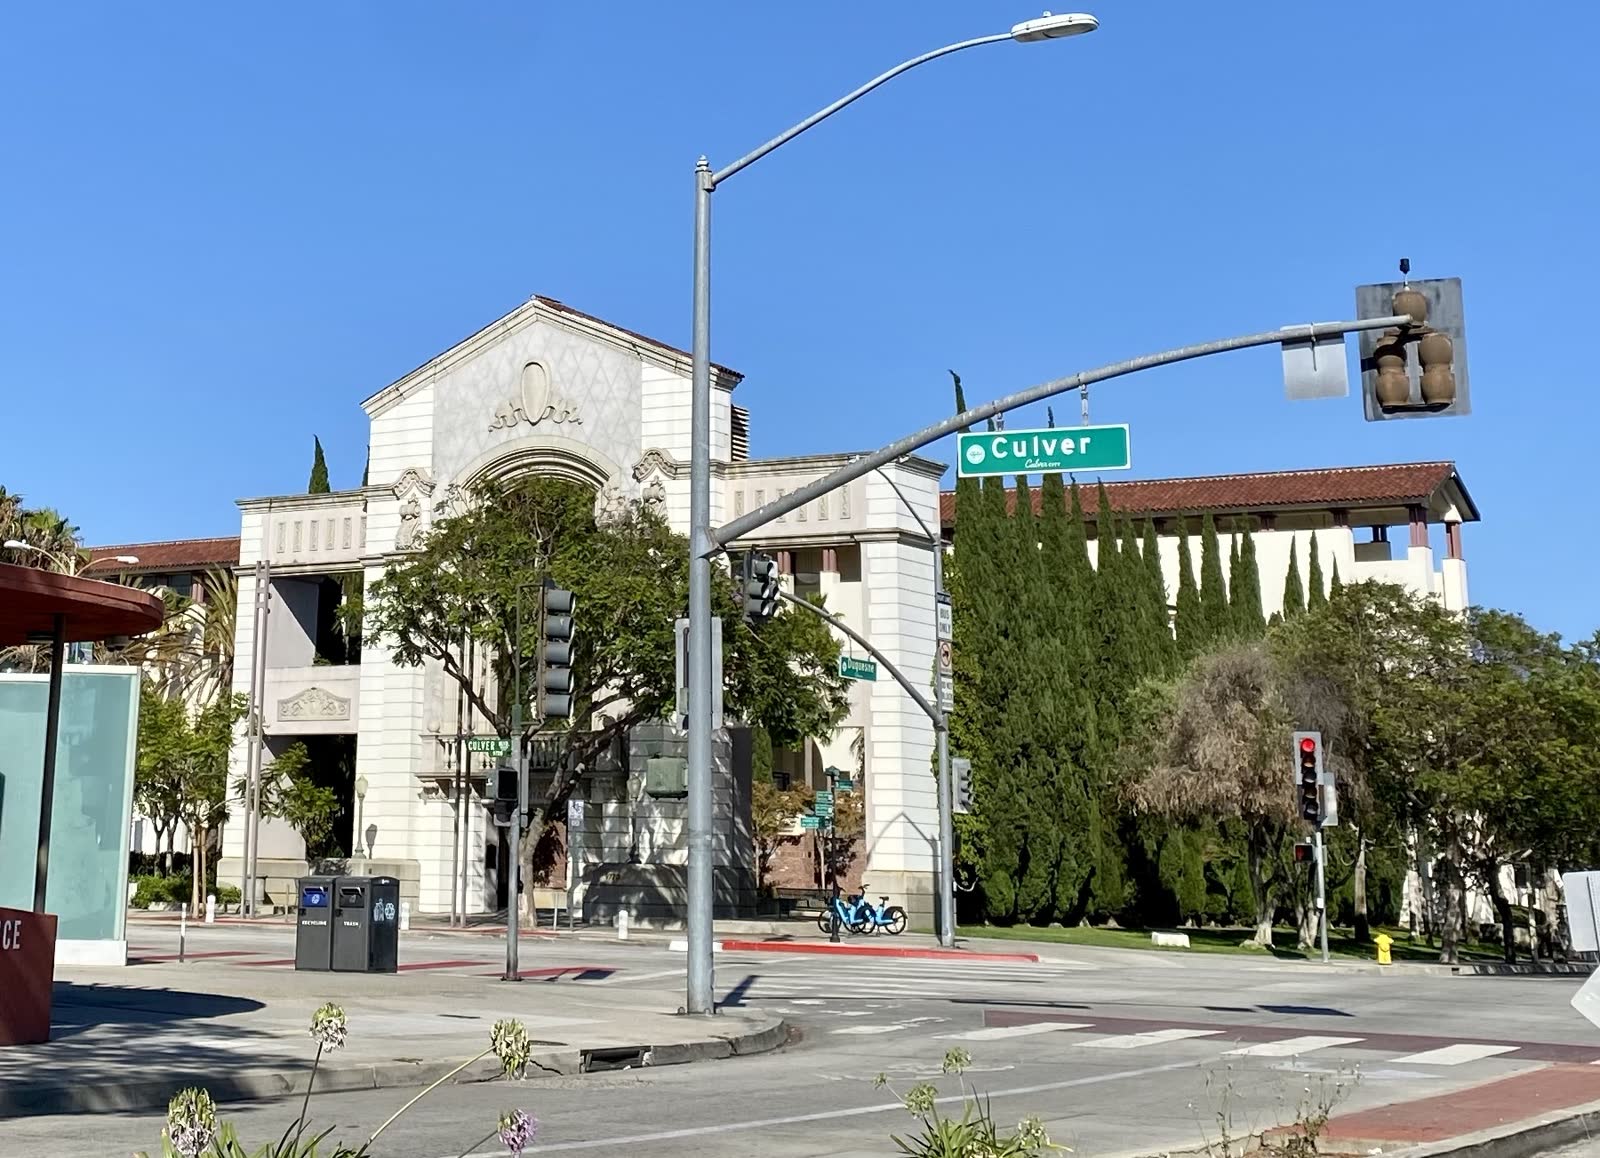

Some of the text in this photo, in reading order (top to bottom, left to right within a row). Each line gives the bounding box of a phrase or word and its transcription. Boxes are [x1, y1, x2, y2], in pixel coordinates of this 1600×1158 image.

[991, 435, 1091, 458] Culver
[940, 608, 950, 619] BUS
[847, 660, 875, 673] Duquesne
[467, 740, 495, 751] CULVER
[0, 920, 21, 950] CE
